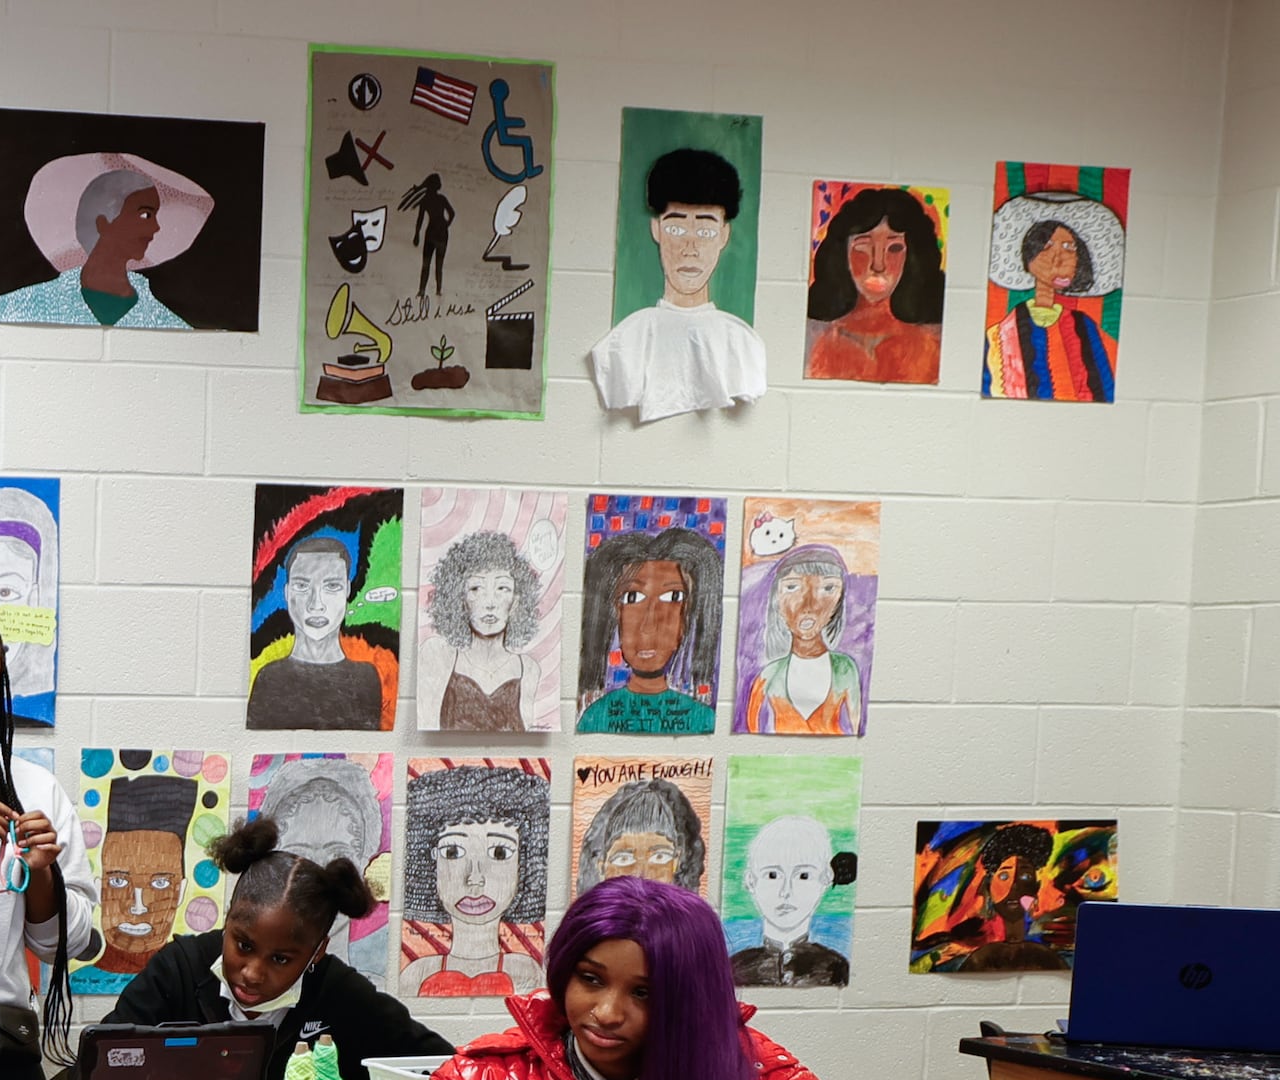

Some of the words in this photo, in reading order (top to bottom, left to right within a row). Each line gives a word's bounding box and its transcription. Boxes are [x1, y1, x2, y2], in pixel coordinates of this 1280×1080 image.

[590, 764, 616, 787] YOU
[618, 763, 646, 782] ARE
[652, 758, 713, 779] ENOUGH!
[303, 1020, 323, 1032] NIKE
